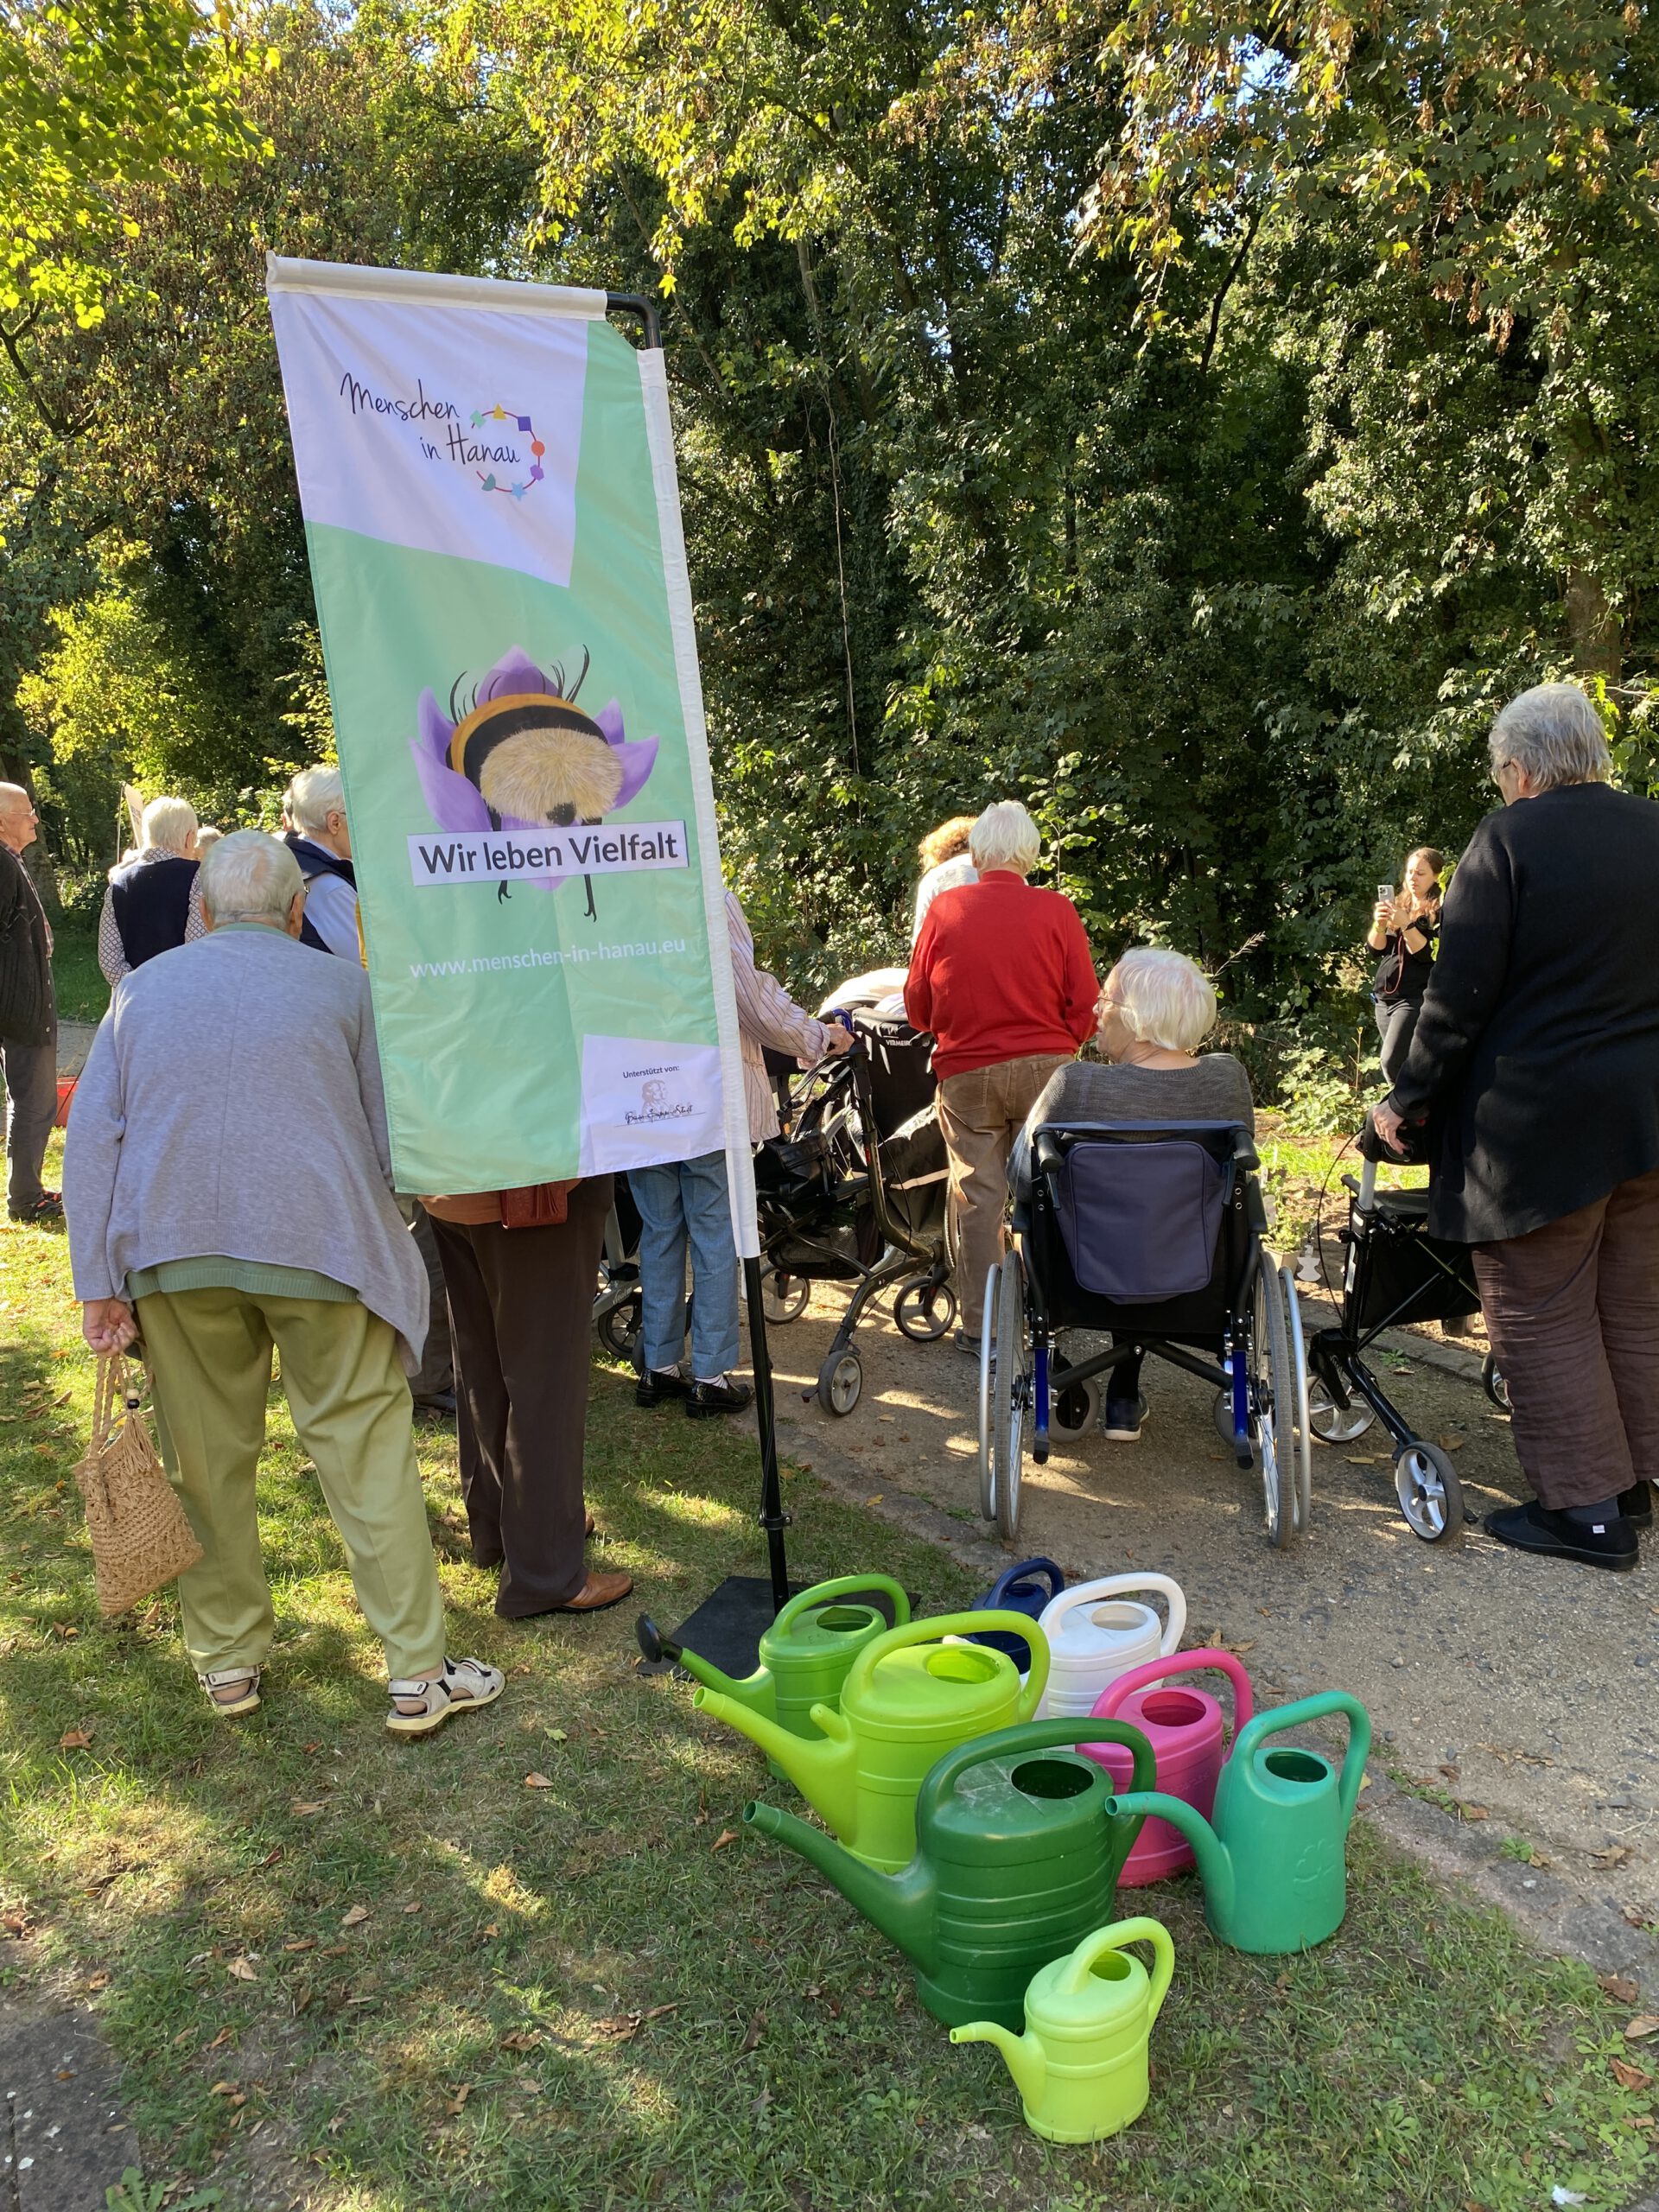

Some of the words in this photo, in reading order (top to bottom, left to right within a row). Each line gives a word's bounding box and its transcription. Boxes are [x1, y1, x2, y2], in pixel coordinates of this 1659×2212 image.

[340, 372, 460, 421] Menschen
[420, 436, 442, 460] in
[446, 423, 520, 465] Hanau
[418, 842, 477, 874] Wir
[483, 841, 563, 871] leben
[568, 831, 679, 864] Vielfalt
[410, 938, 686, 979] www.menschen-in-hanau.eu
[622, 1067, 663, 1078] Unterstützt
